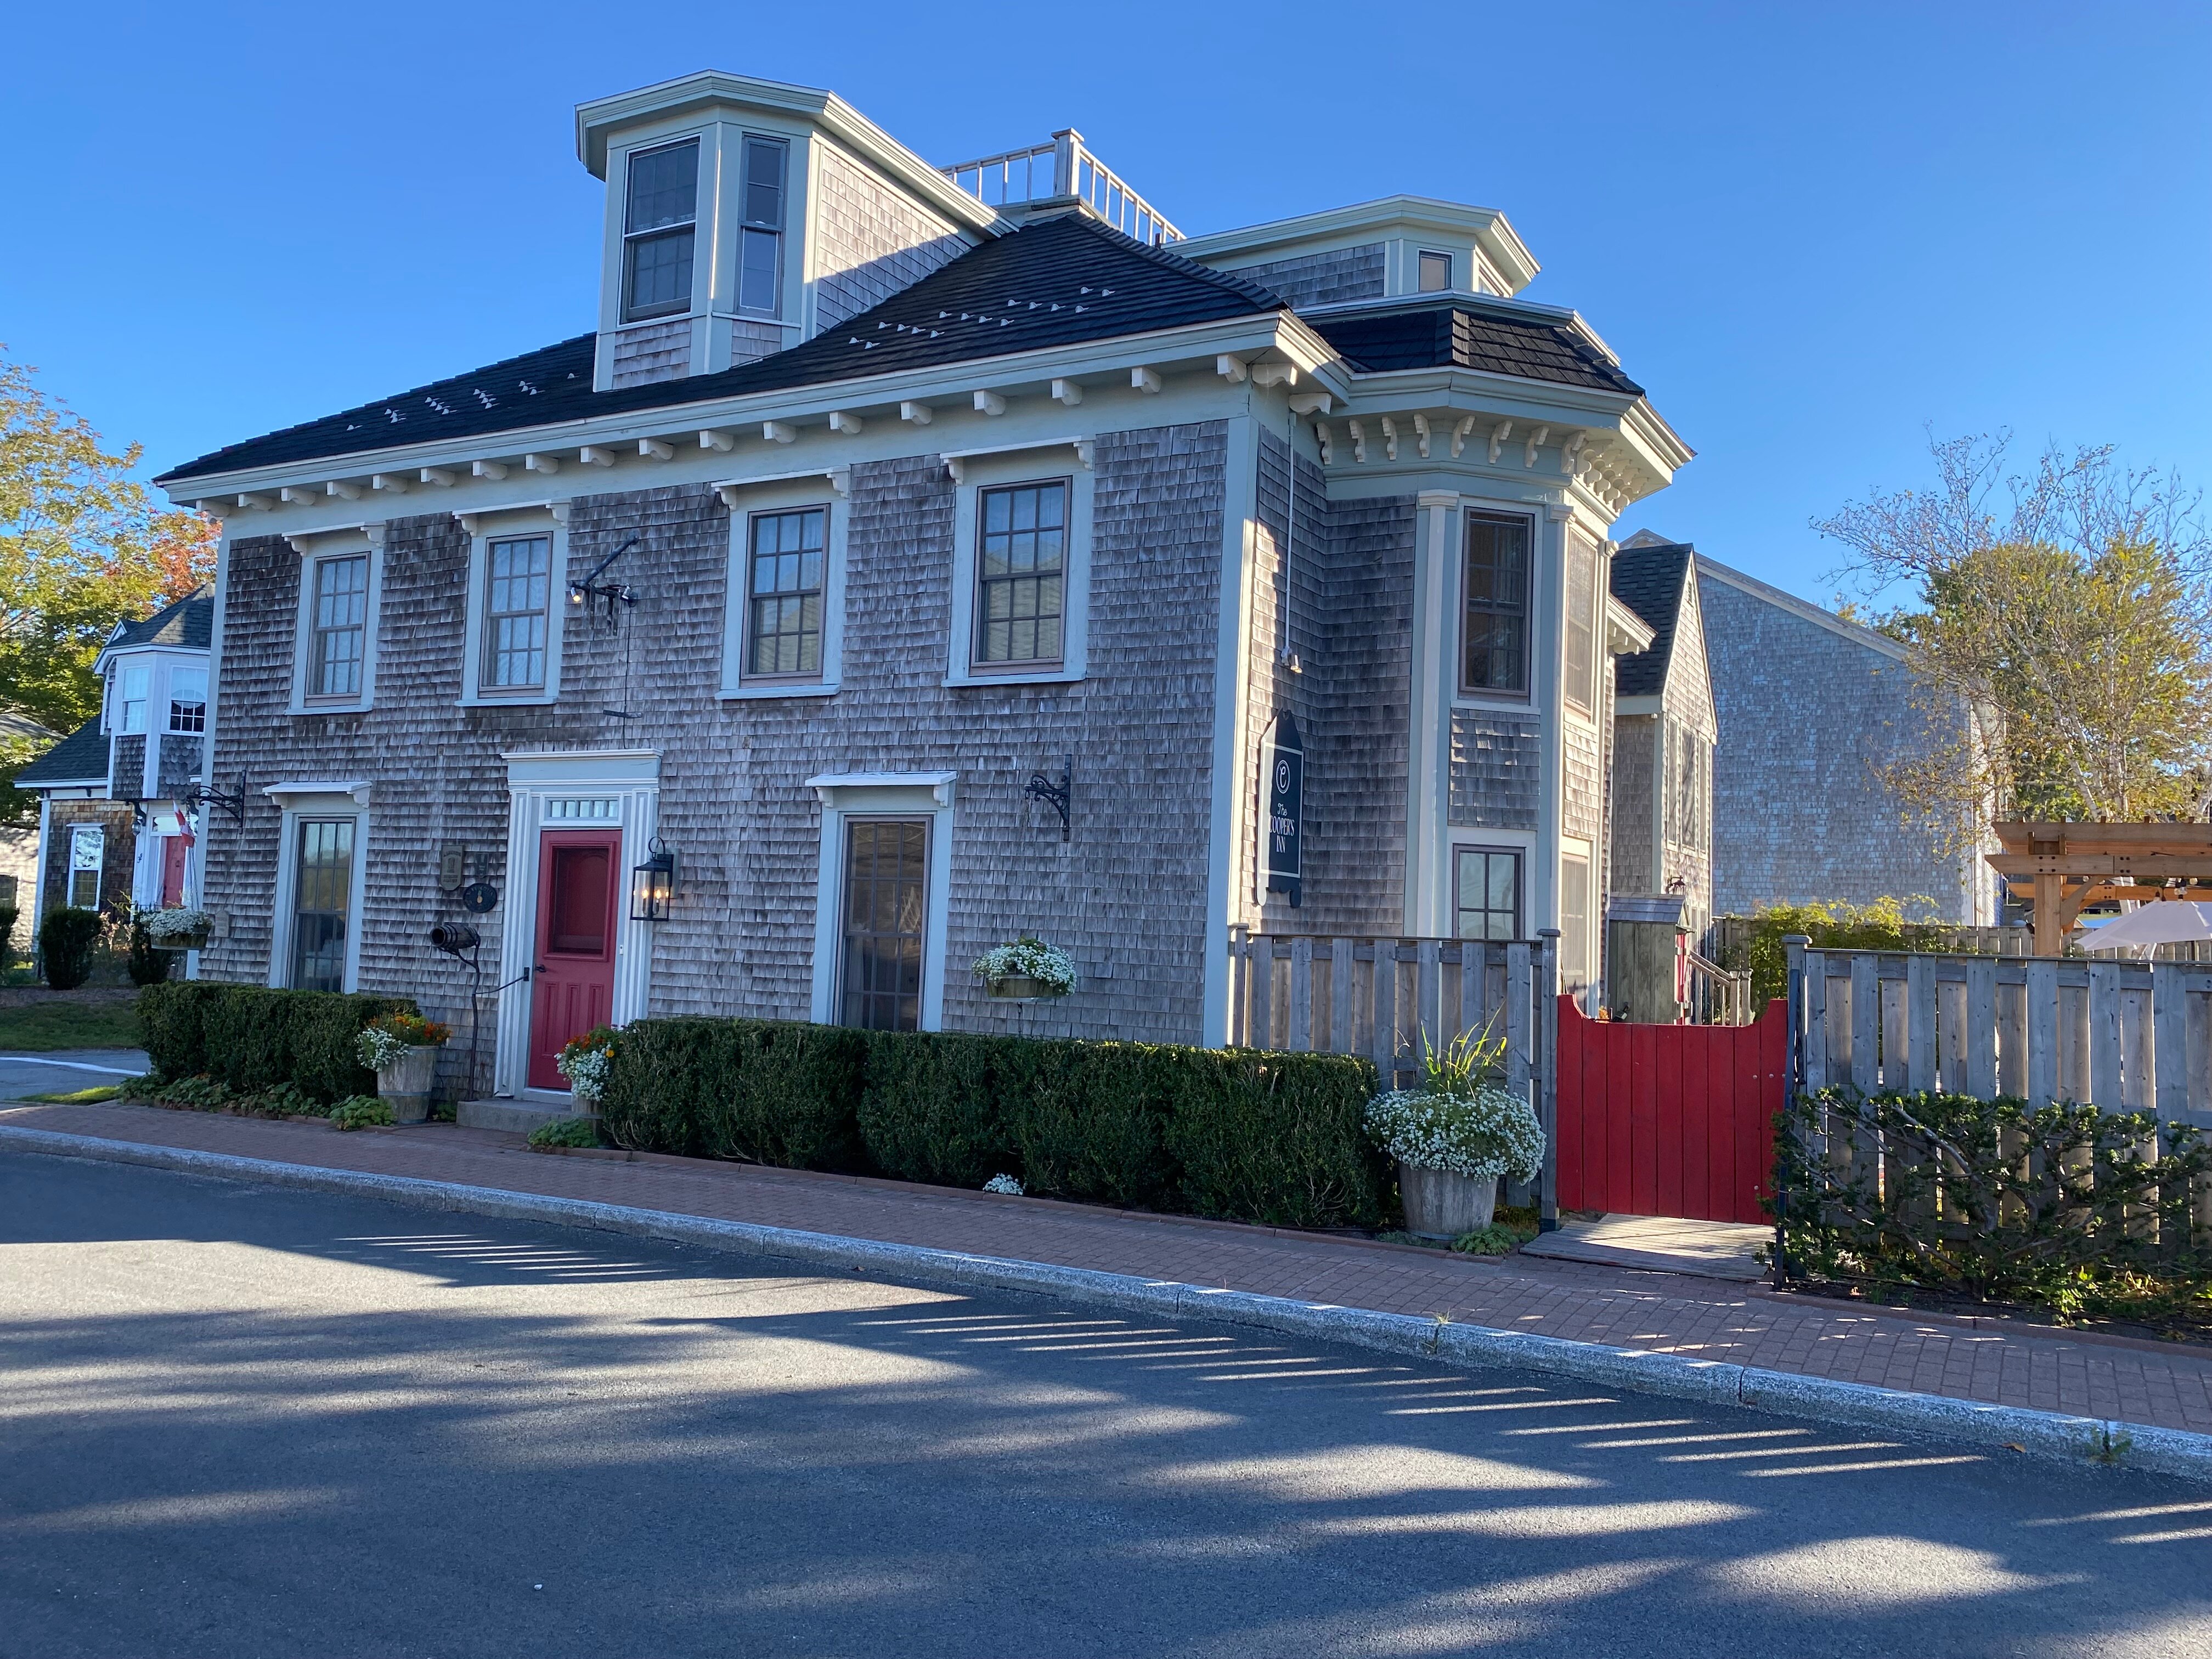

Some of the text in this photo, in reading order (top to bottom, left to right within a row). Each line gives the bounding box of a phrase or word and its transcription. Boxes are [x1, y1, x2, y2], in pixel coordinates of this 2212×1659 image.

[1277, 803, 1288, 816] The
[1269, 815, 1295, 837] COOPER'S
[1276, 835, 1286, 853] INN
